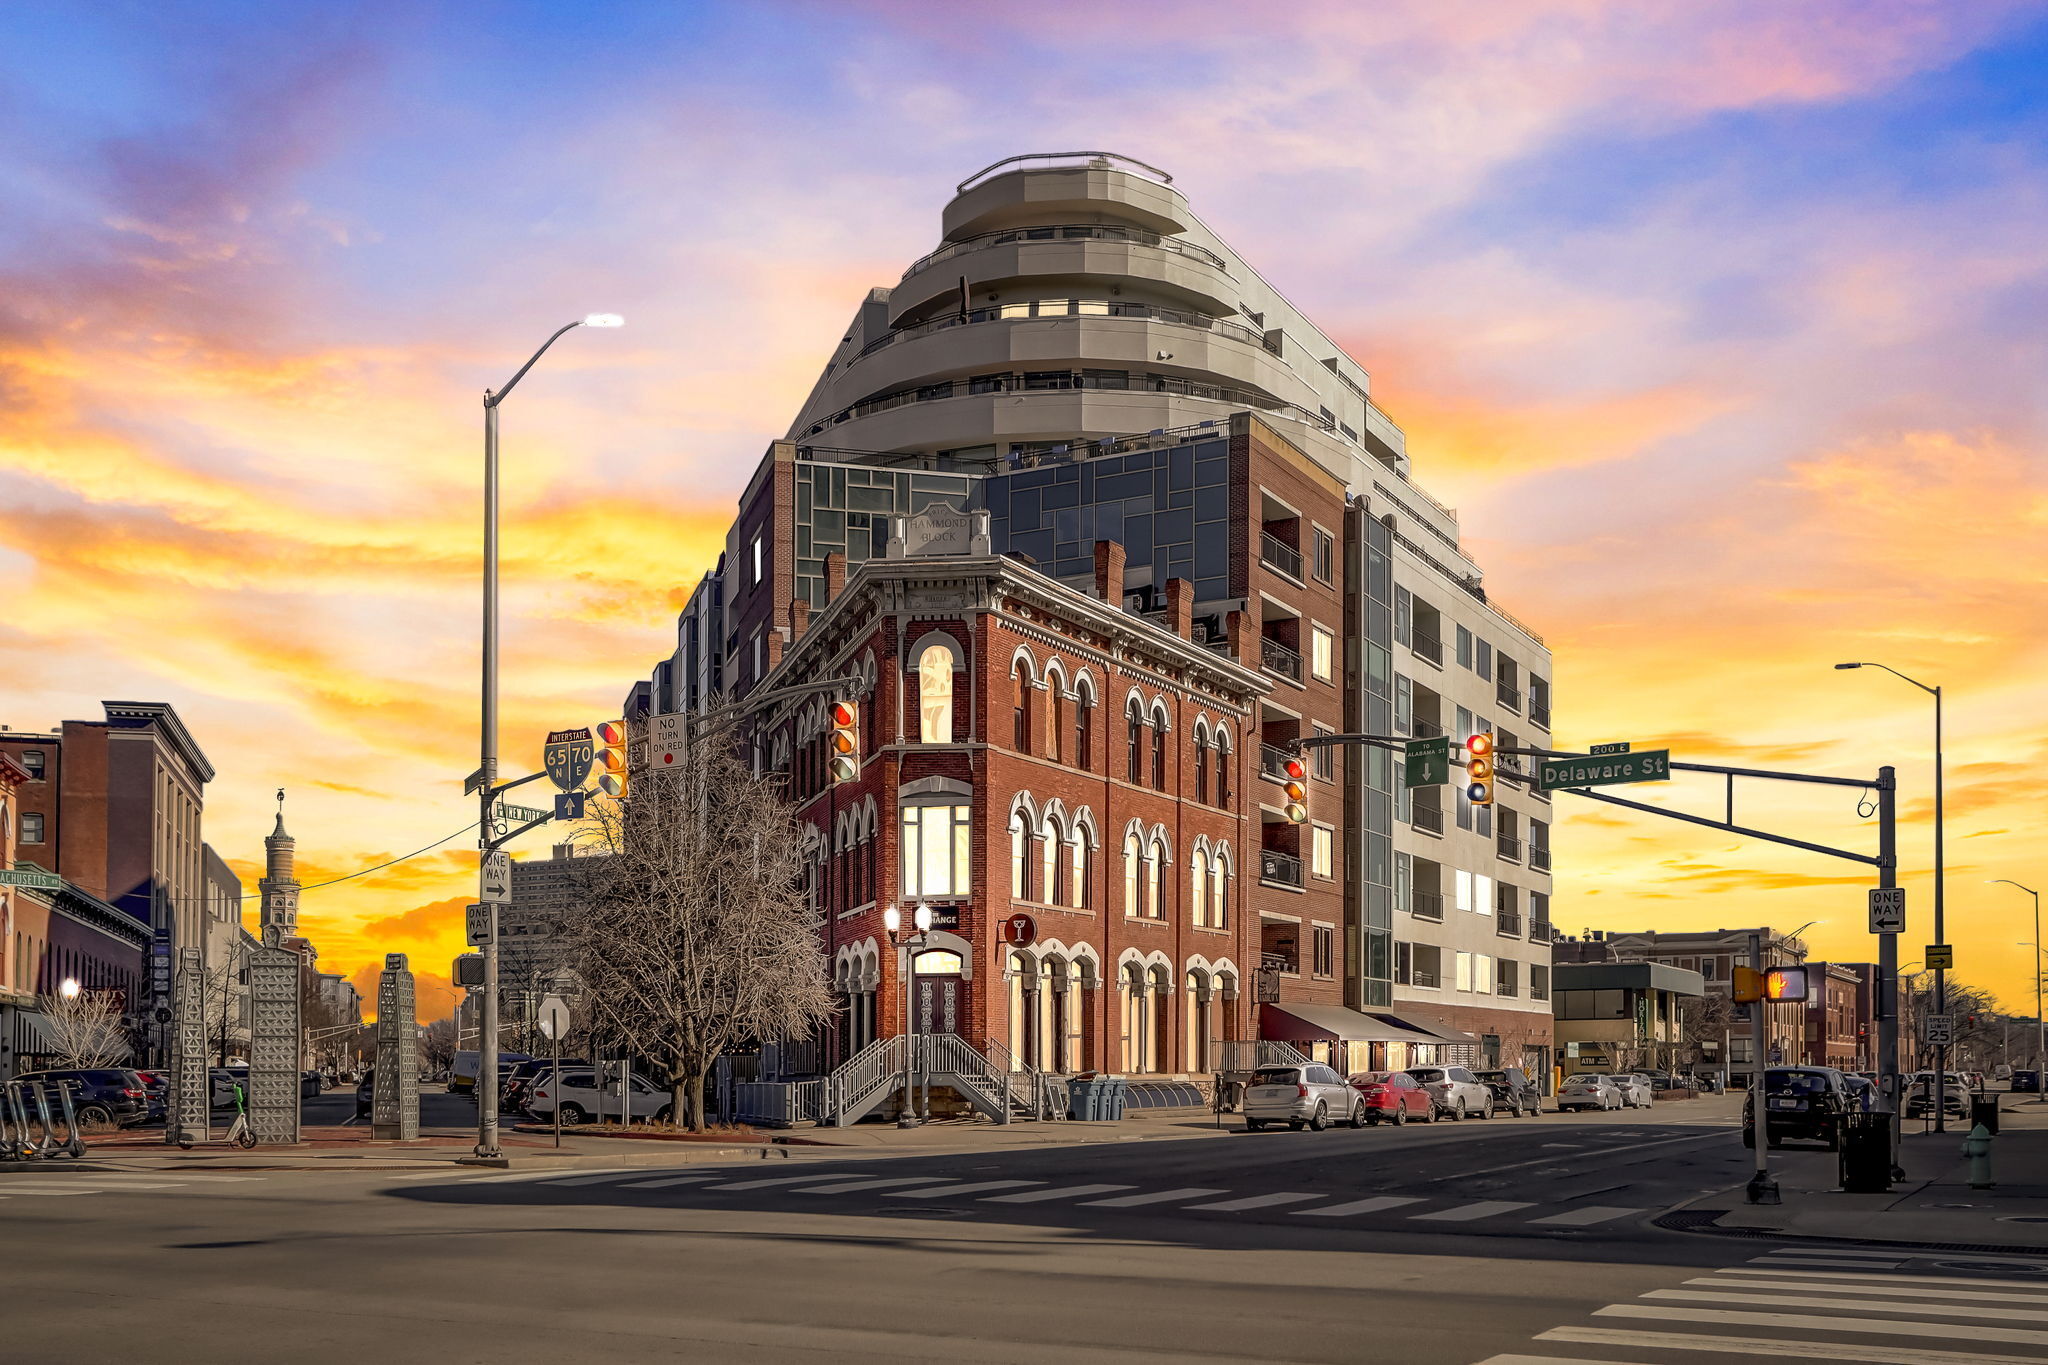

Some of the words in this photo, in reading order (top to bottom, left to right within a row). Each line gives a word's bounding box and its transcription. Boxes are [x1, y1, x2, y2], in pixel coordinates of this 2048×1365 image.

[910, 518, 967, 528] HAMMOND
[921, 532, 956, 542] BLOCK
[660, 718, 675, 729] NO
[551, 730, 587, 742] INTERSTATE
[658, 730, 678, 740] TURN
[653, 744, 664, 752] ON
[668, 741, 683, 750] RED
[1593, 745, 1615, 754] 200
[1619, 743, 1626, 751] E
[547, 749, 566, 766] 65
[571, 746, 590, 763] 70
[556, 767, 562, 778] N
[576, 765, 582, 776] E
[1545, 763, 1632, 783] Delaware
[1641, 757, 1663, 774] St
[486, 854, 506, 867] ONE
[485, 867, 506, 880] WAY
[1873, 892, 1900, 903] ONE
[469, 907, 488, 918] ONE
[1873, 904, 1901, 915] WAY
[468, 918, 489, 929] WAY
[1929, 1030, 1949, 1041] 25
[1581, 1057, 1595, 1065] ATM
